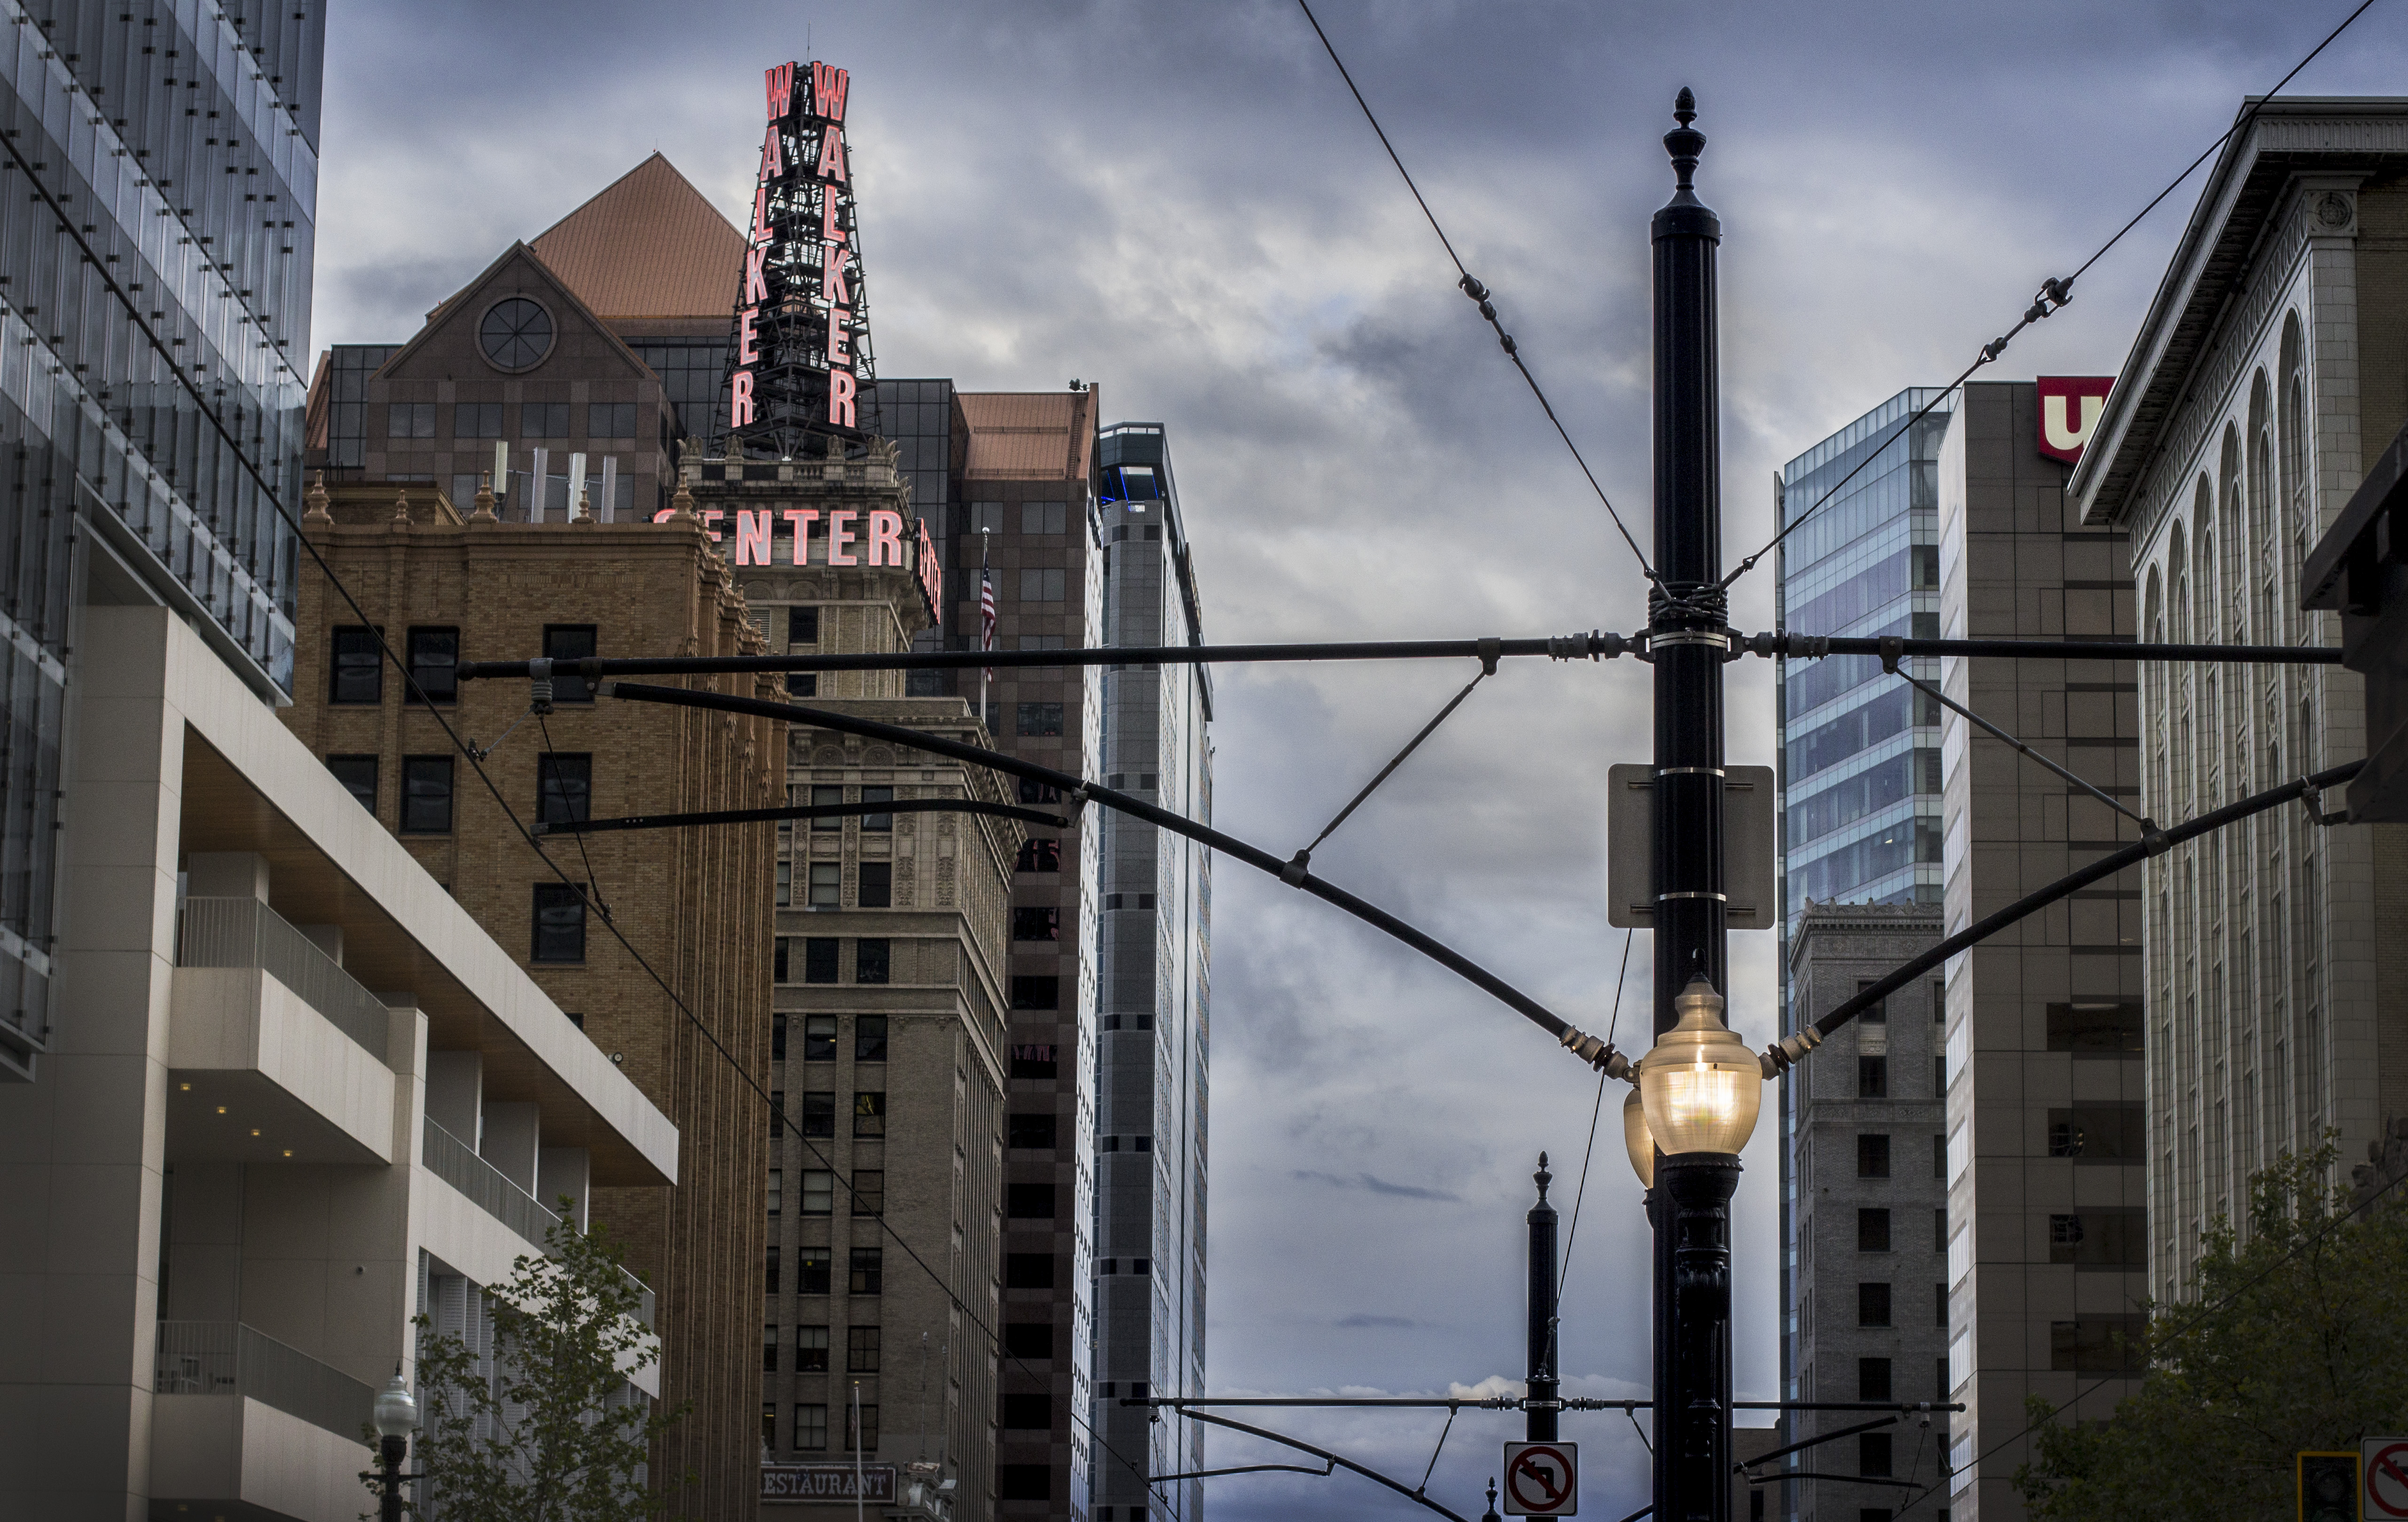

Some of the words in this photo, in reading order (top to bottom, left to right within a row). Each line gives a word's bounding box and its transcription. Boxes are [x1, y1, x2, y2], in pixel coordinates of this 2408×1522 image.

[732, 62, 794, 428] WALKER
[813, 62, 856, 428] WALKER
[653, 508, 902, 566] NTER
[760, 1473, 886, 1496] ESTAURANT
